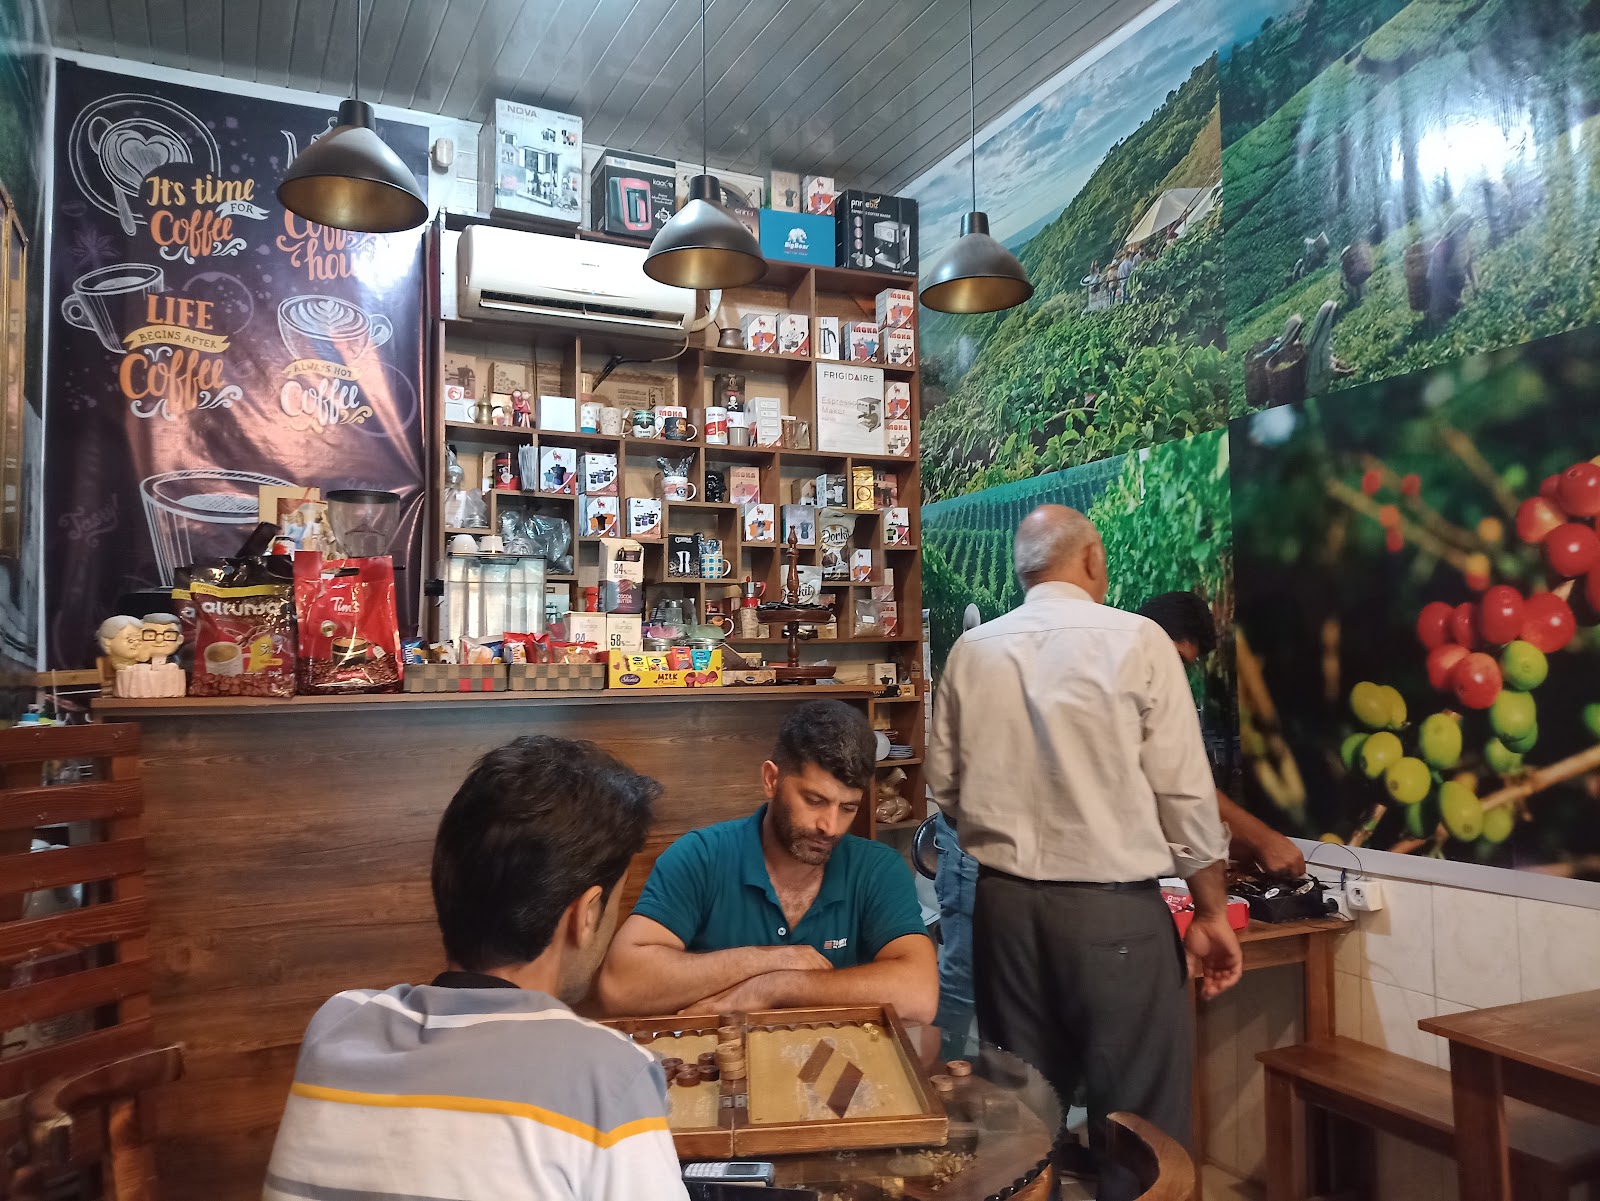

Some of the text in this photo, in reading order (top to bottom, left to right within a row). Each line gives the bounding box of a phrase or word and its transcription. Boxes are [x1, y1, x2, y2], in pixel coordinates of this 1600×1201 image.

[507, 104, 538, 118] NOVA
[145, 174, 255, 206] It's time
[230, 203, 254, 215] FOR
[150, 208, 234, 257] Coffee
[304, 237, 357, 281] hou
[890, 293, 911, 301] MOKA
[146, 294, 214, 330] LIFE
[853, 326, 878, 334] MOKA
[138, 330, 217, 349] BEGINS AFTER
[334, 366, 353, 378] HOT
[823, 371, 874, 383] FRIGIDAIRE
[119, 349, 225, 413] Coffee
[280, 378, 360, 427] Coffee
[821, 397, 857, 406] Espresso
[659, 410, 684, 418] MOKA
[821, 406, 846, 415] Maker
[732, 471, 756, 479] MOKA
